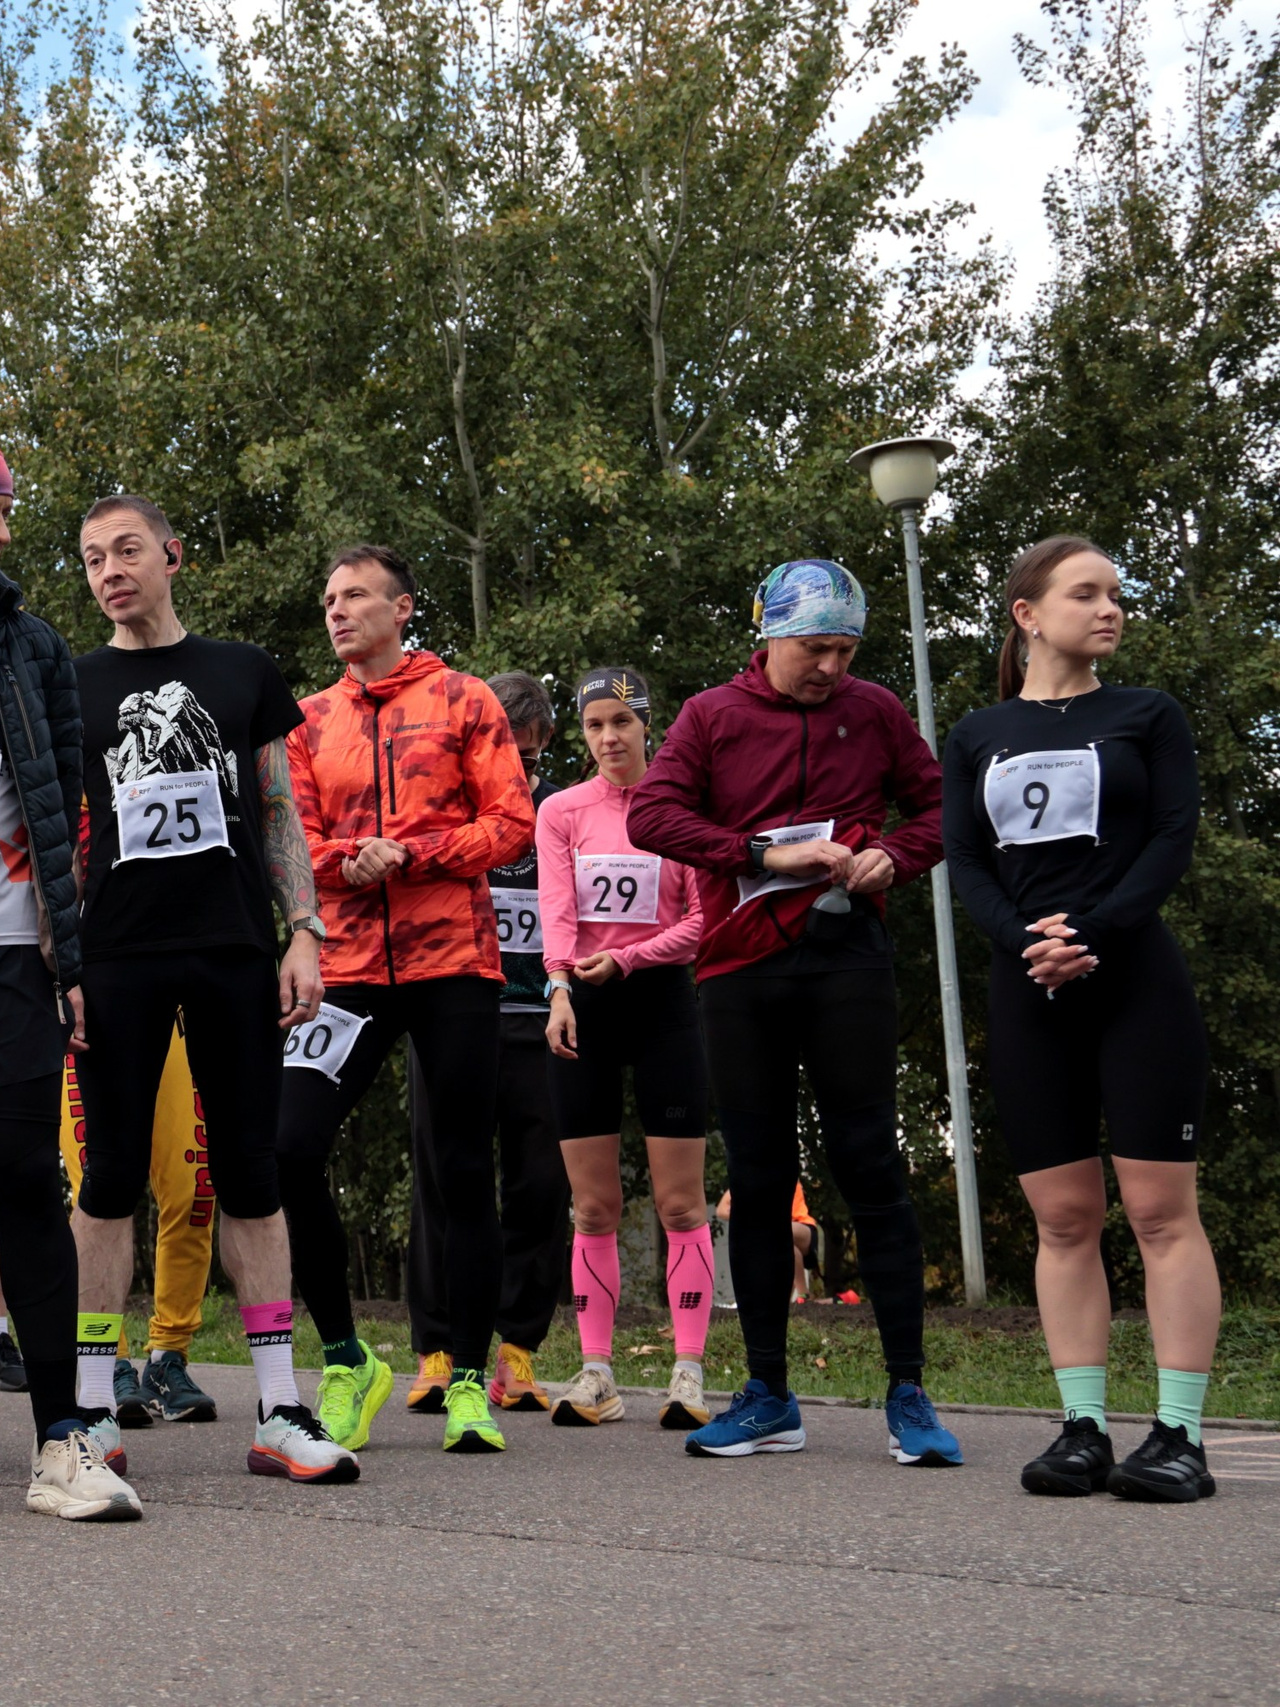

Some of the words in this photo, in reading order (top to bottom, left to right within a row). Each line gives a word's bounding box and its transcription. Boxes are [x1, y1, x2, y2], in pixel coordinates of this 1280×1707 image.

[1055, 760, 1084, 769] PEOPLE
[184, 780, 209, 788] PEOPLE
[1022, 781, 1050, 829] 9
[143, 797, 202, 849] 25
[800, 832, 822, 840] PEOPLE
[514, 863, 536, 876] TRAIL
[592, 875, 638, 913] 29
[494, 908, 537, 944] 59
[330, 1013, 351, 1028] PEOPLE
[284, 1023, 333, 1060] 60
[453, 1367, 483, 1376] CRIT
